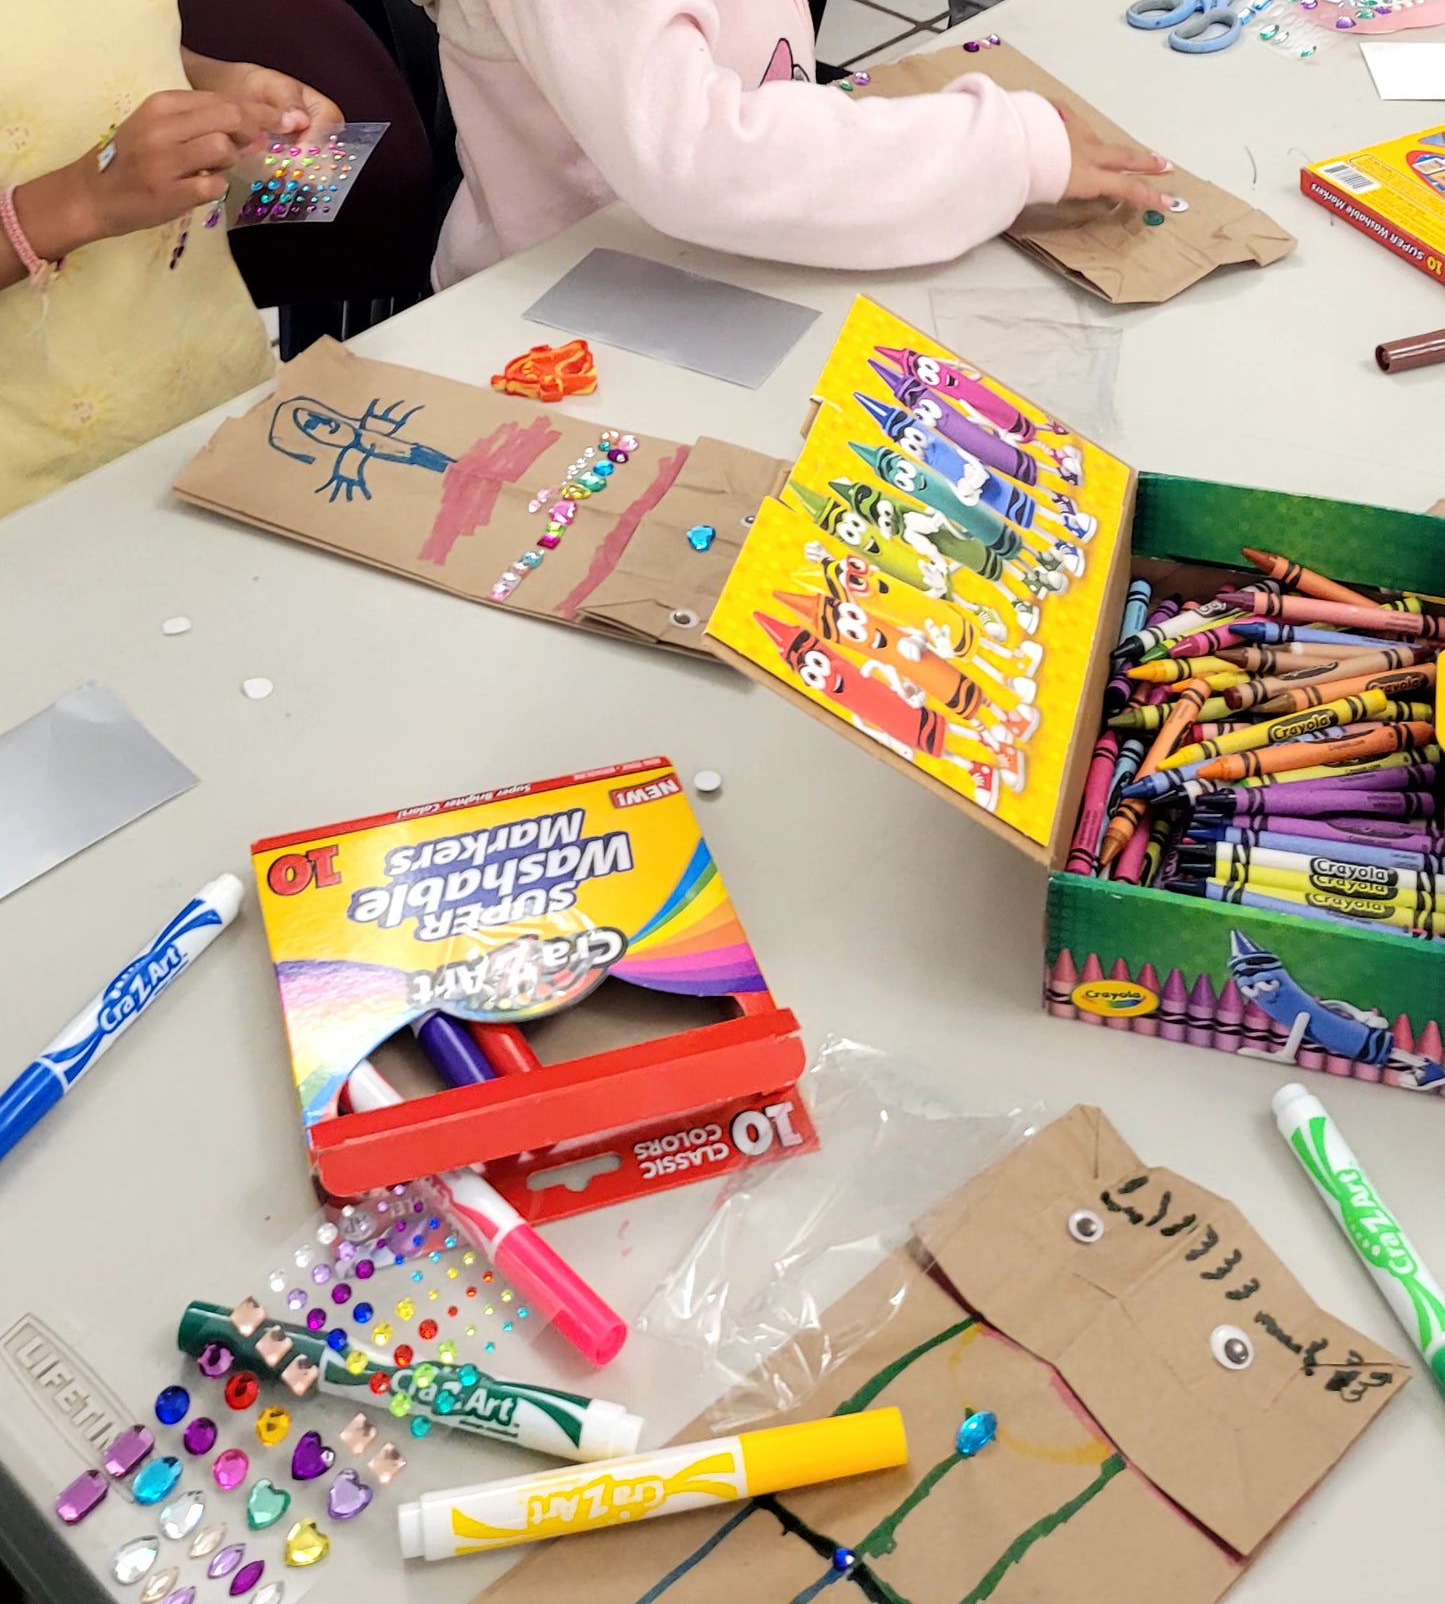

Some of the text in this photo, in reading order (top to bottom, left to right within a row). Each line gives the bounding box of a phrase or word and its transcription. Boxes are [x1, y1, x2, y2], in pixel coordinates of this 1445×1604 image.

[1311, 182, 1346, 210] Markers
[1346, 206, 1390, 239] Washable
[1390, 234, 1425, 261] SUPER
[1427, 256, 1443, 276] 10
[1271, 714, 1331, 741] Crayola
[495, 783, 531, 797] Super
[615, 778, 681, 807] NEW!
[389, 810, 584, 874] Markers
[267, 843, 342, 896] 10
[354, 833, 632, 928] Washable
[1315, 858, 1387, 881] Crayola
[422, 882, 577, 941] SUPER
[1085, 989, 1142, 1000] Crayola
[633, 1123, 722, 1161] COLORS
[731, 1101, 803, 1156] 10
[639, 1142, 729, 1179] CLASSIC
[16, 1334, 119, 1452] LIFETI
